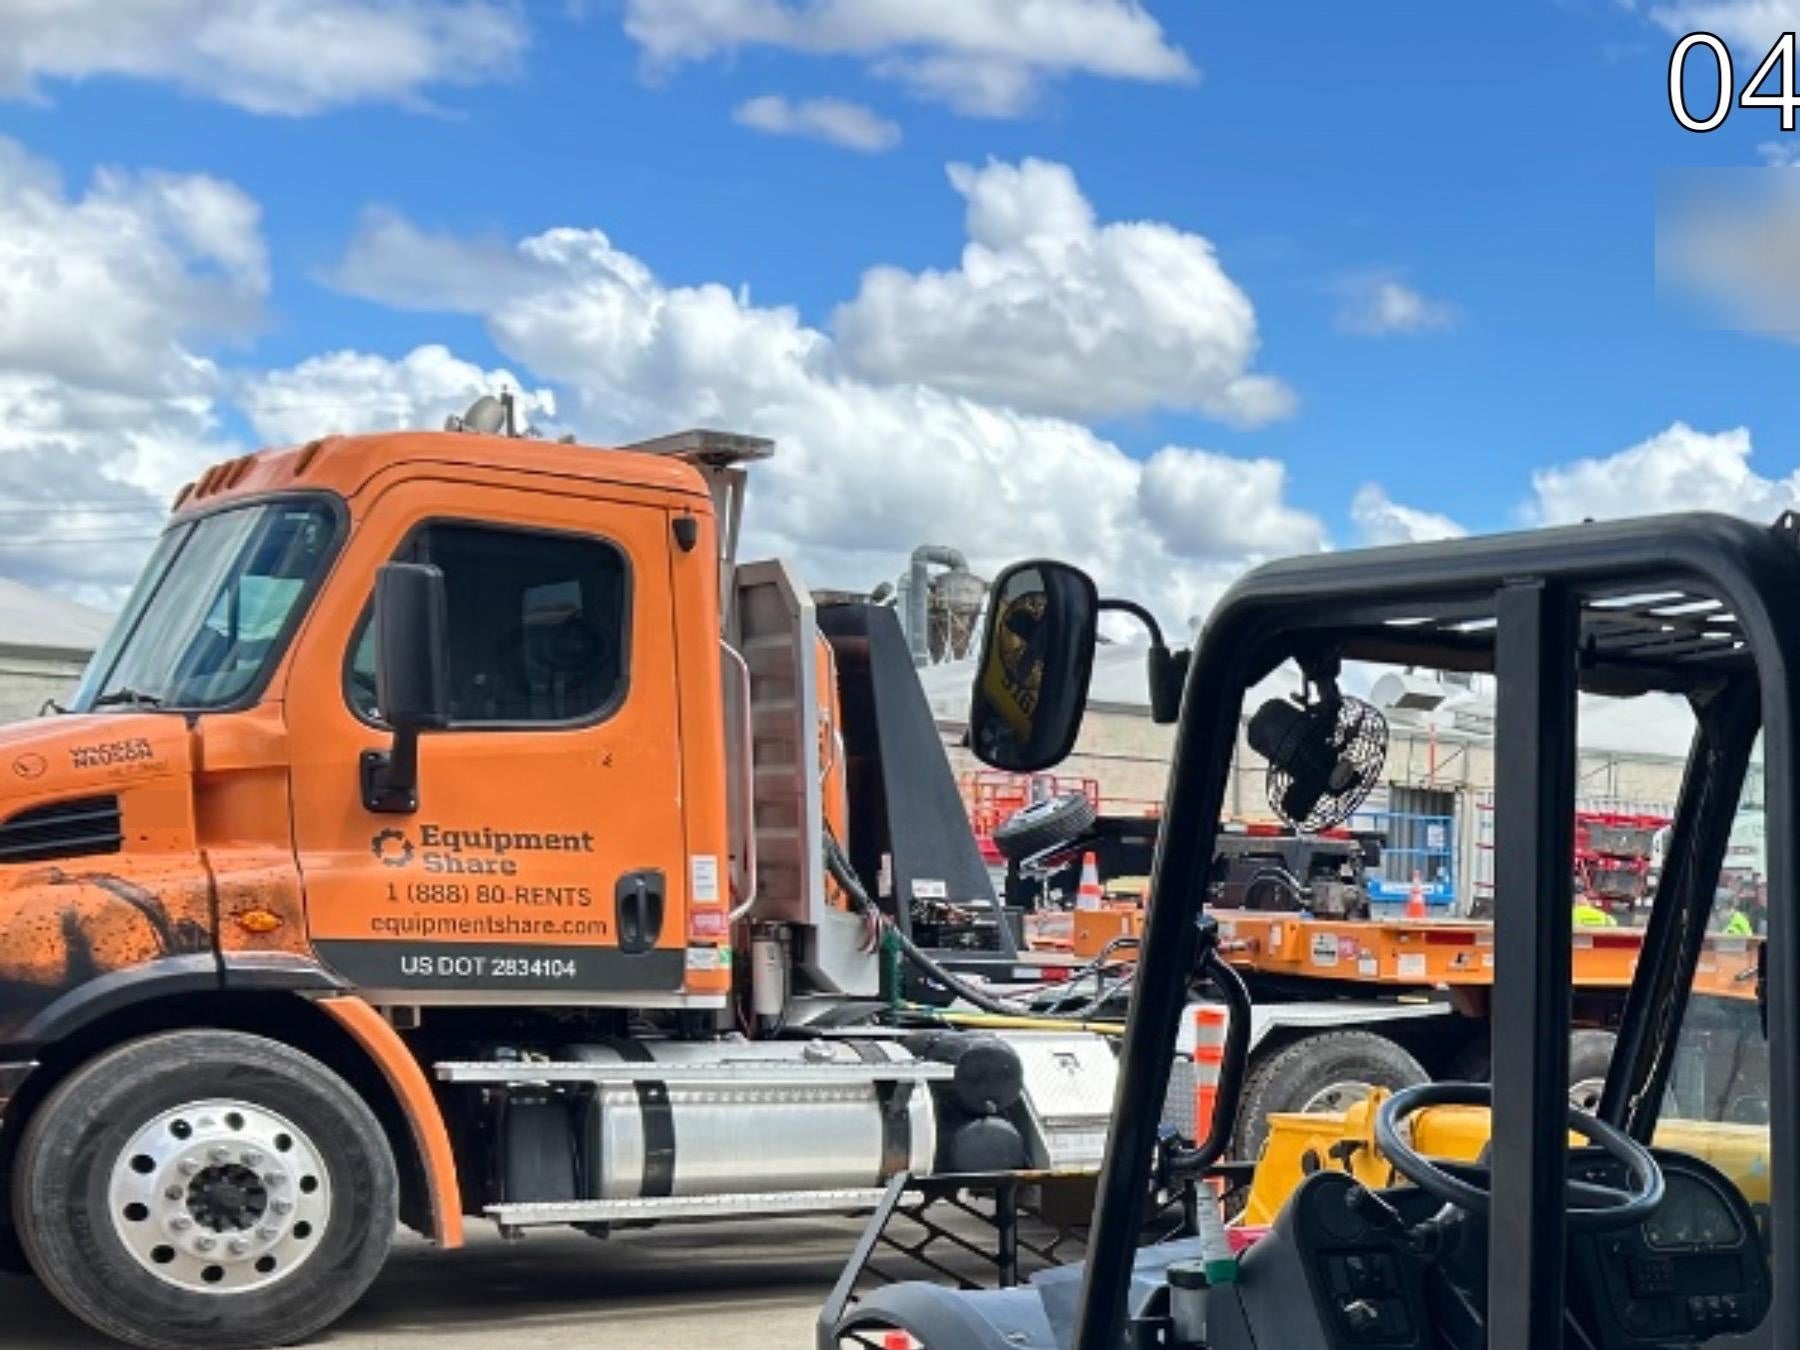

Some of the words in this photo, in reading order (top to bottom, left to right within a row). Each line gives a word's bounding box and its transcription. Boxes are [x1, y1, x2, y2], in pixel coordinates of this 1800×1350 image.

[420, 825, 594, 853] Equipment
[424, 851, 518, 876] Share
[387, 883, 398, 901] 1
[407, 882, 469, 905] (888)
[476, 885, 593, 907] 80-RENTS
[371, 914, 608, 936] equipmentshare.com
[400, 955, 433, 976] US
[438, 956, 487, 976] DOT
[491, 958, 577, 977] 2834104
